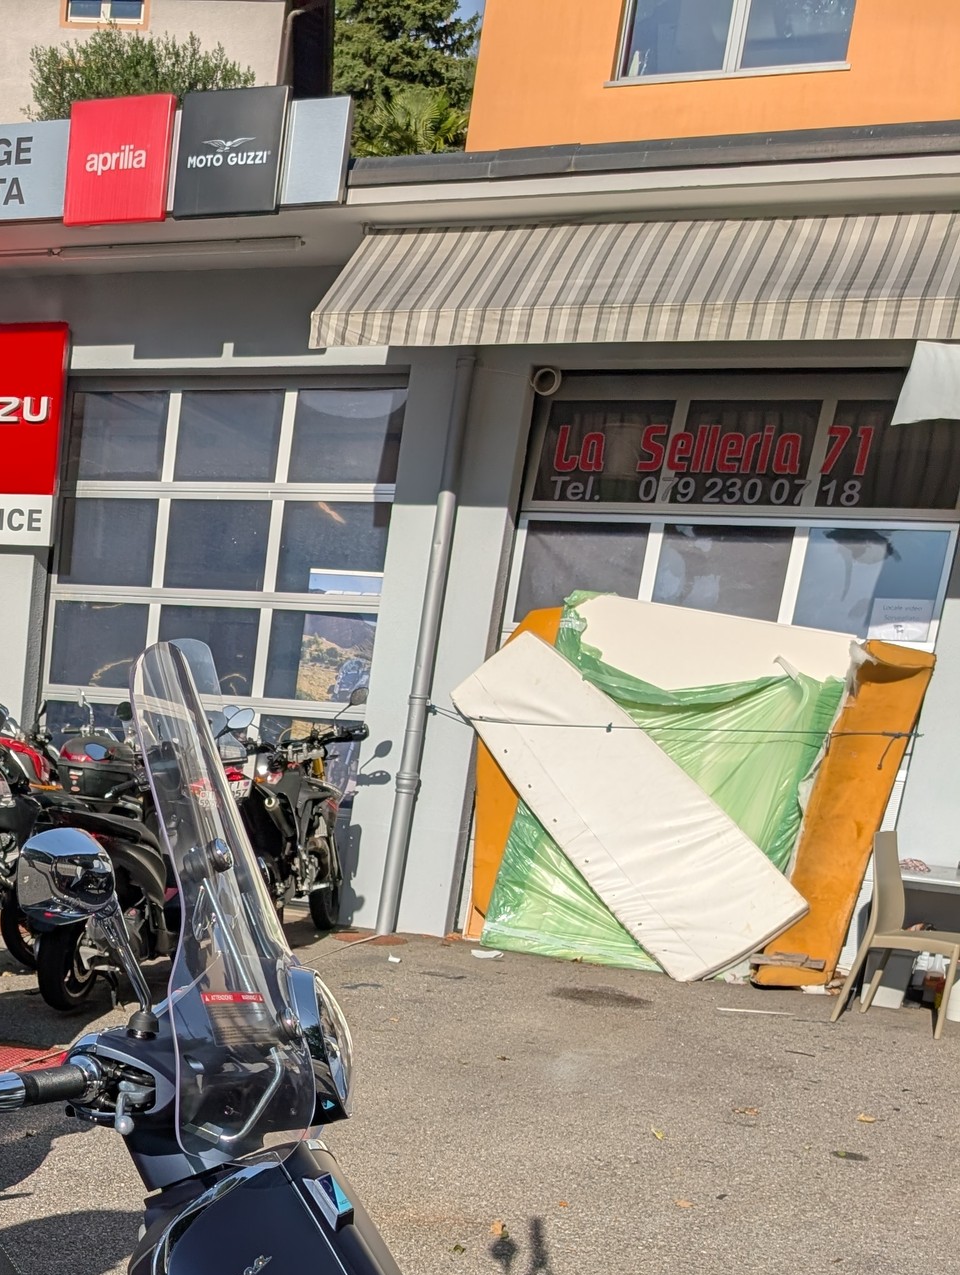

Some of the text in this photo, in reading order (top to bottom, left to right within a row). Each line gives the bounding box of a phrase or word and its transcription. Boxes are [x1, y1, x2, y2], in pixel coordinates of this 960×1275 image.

[85, 144, 146, 176] aprilia
[187, 151, 267, 169] MOTO GUZZI
[553, 424, 875, 477] La Selleria 71
[550, 476, 861, 506] Tel. 079 230 07 18
